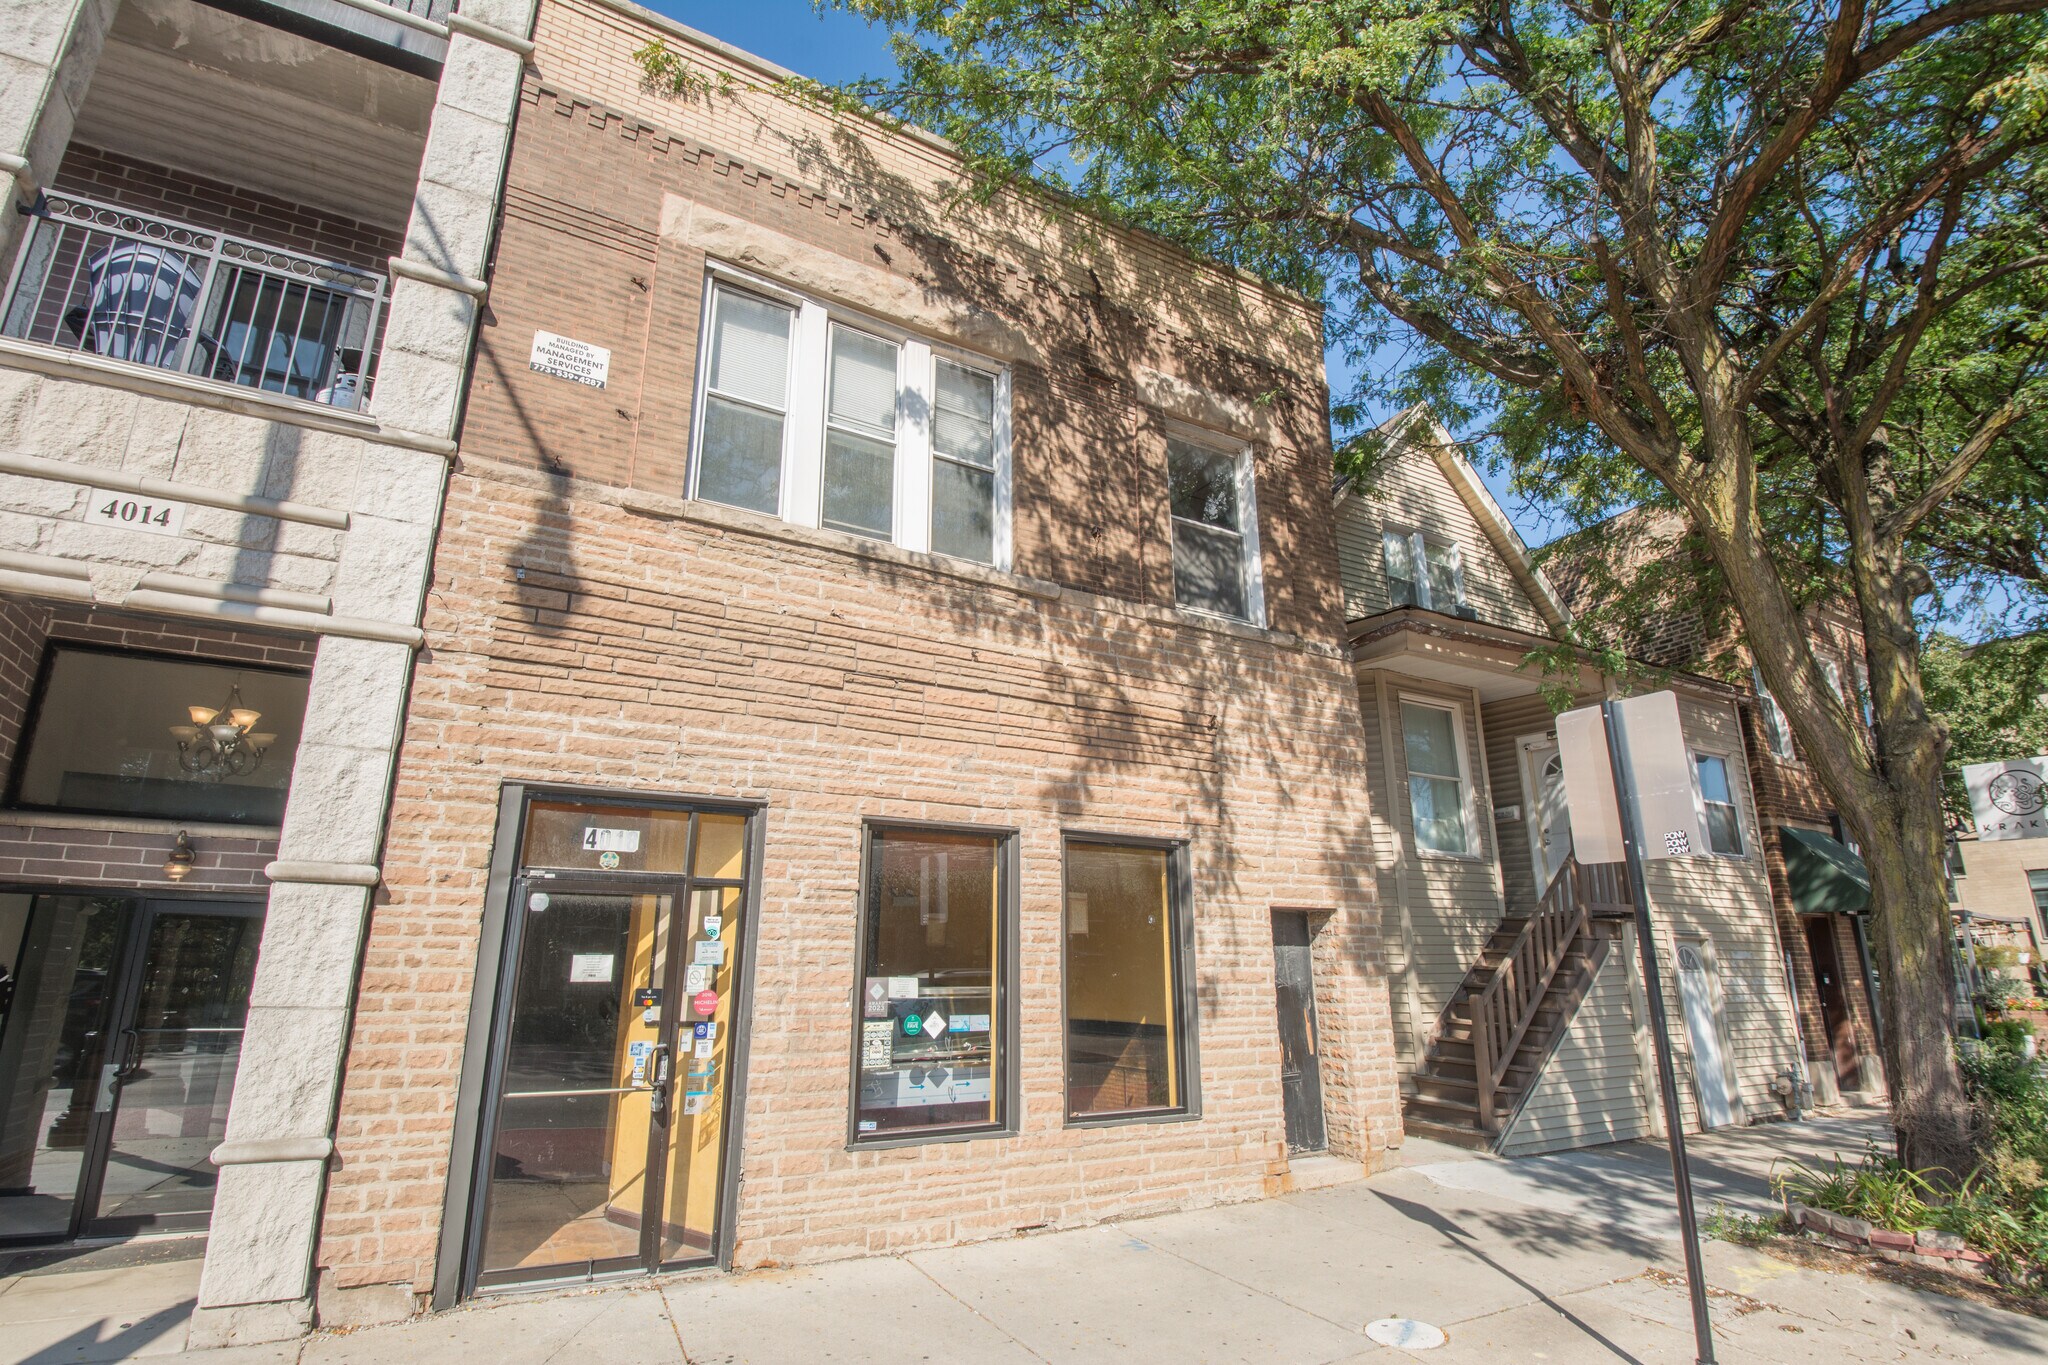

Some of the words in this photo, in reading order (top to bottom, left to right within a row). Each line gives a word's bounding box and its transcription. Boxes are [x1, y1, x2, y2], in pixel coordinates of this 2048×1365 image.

[548, 341, 584, 356] MANAGED
[556, 337, 589, 351] BUILDING
[536, 345, 604, 370] MANAGEMENT
[547, 357, 592, 375] SERVICES
[101, 499, 171, 527] 4014
[1664, 830, 1686, 840] PONY
[1665, 837, 1688, 848] PONY
[1668, 845, 1689, 855] PONY
